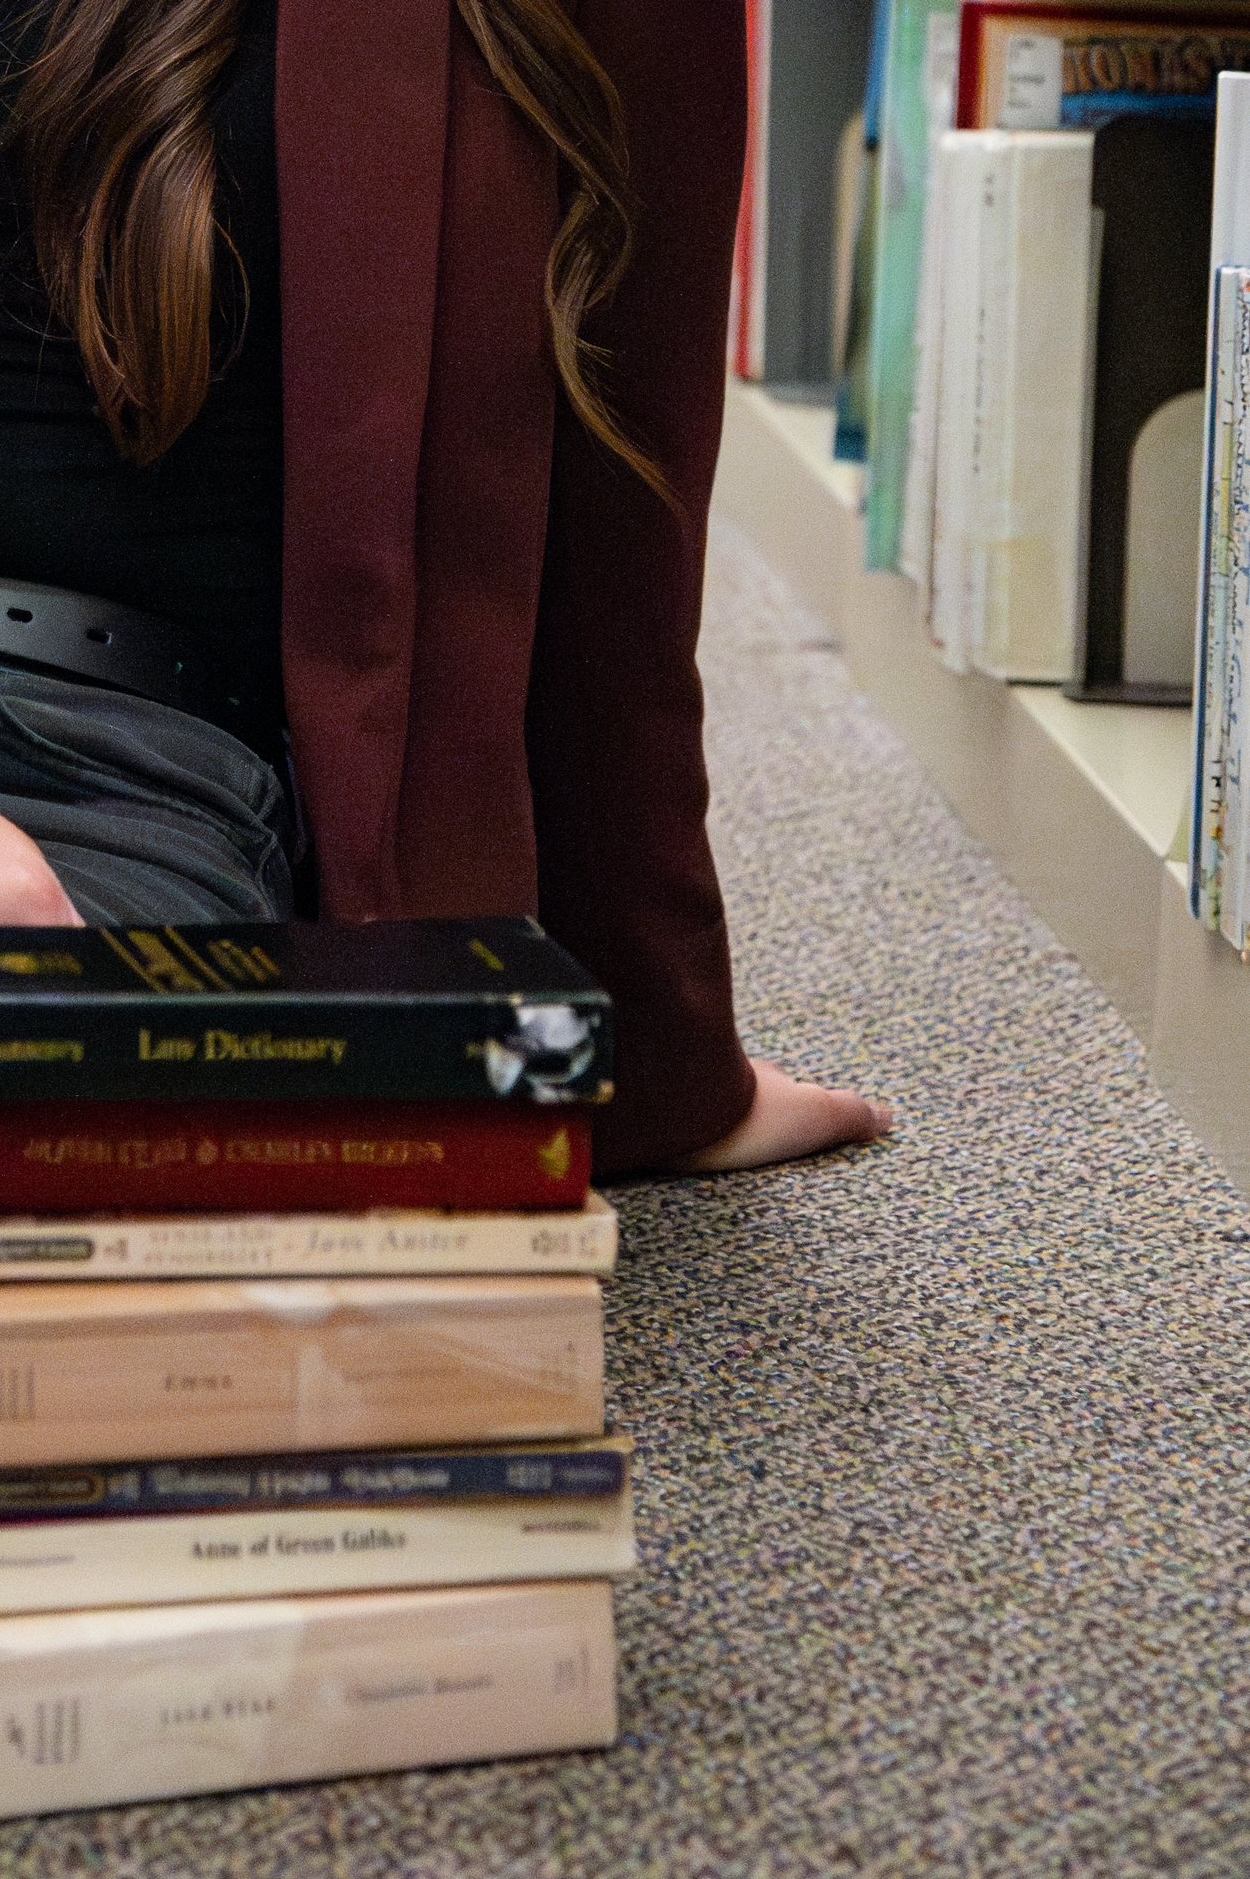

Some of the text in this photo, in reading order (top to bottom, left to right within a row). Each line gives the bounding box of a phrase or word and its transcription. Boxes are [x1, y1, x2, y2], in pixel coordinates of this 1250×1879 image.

[138, 1028, 348, 1067] Law Dictionary
[250, 1533, 270, 1557] of
[275, 1532, 336, 1556] Green
